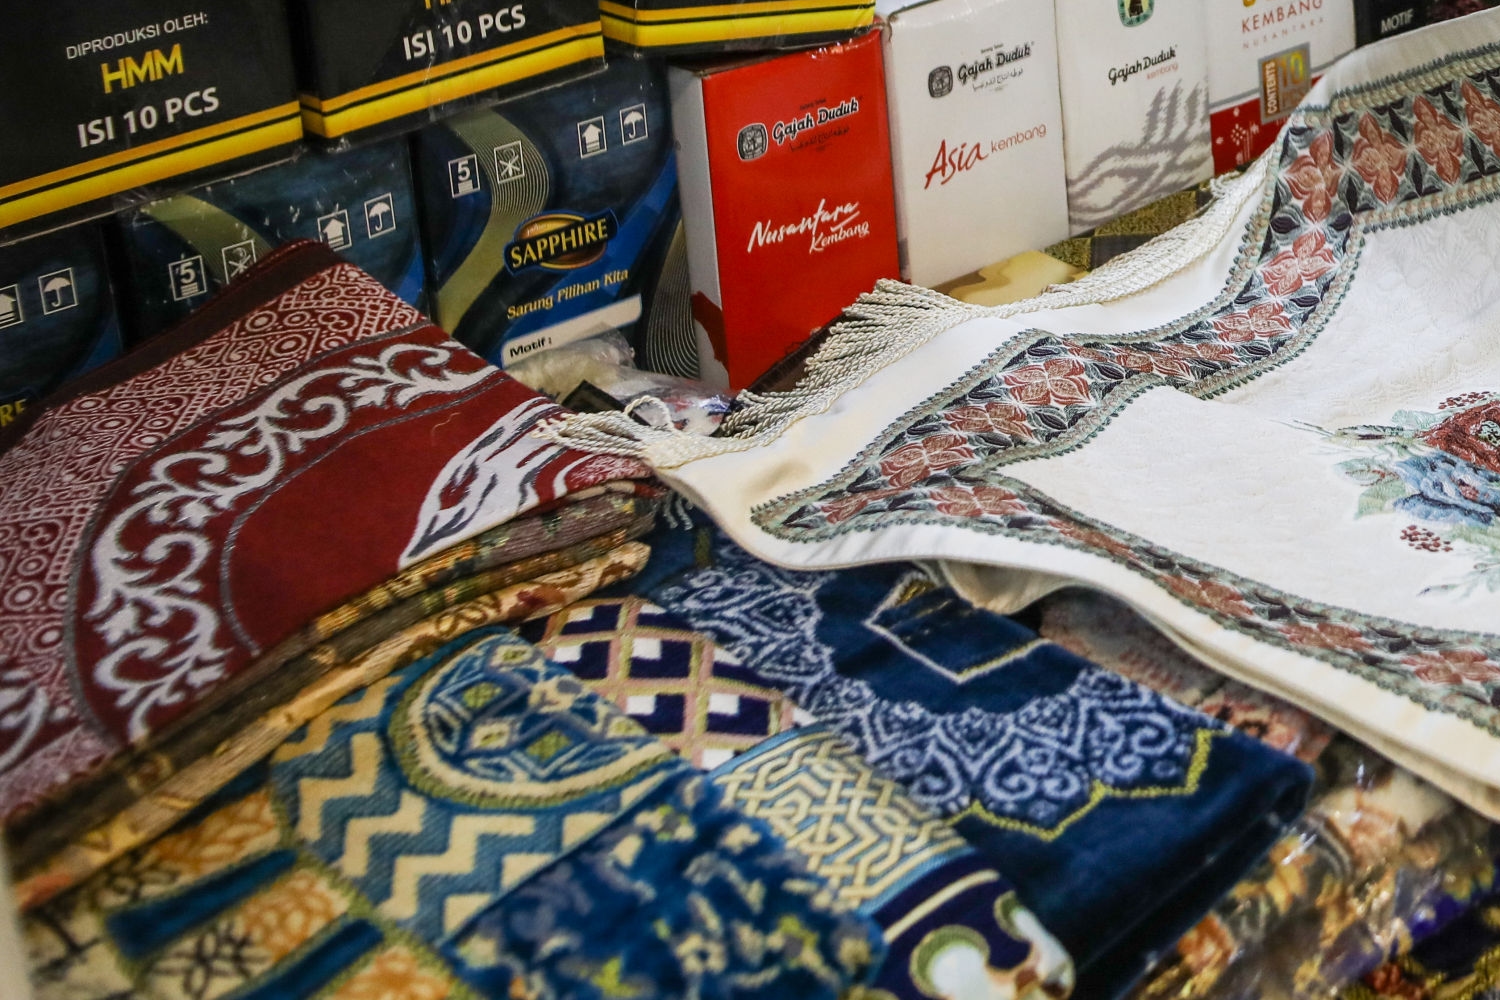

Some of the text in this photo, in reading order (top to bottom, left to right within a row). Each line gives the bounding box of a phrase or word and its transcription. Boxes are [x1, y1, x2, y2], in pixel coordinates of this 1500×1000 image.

[66, 12, 209, 60] DIPRODUKSI OLEH:
[403, 4, 526, 61] ISI 10 PCS
[1243, 17, 1324, 50] NUSANTARA
[1380, 8, 1414, 34] MOTIF
[100, 43, 185, 95] HMM
[958, 58, 993, 86] Gajah
[996, 43, 1031, 68] Duduk
[1108, 46, 1176, 86] Gajah Duduk
[1265, 61, 1278, 114] CONTENTS
[77, 87, 220, 148] ISI 10 PCS
[771, 114, 814, 147] Gajah
[817, 97, 859, 126] Duduk
[457, 160, 471, 182] 5
[924, 124, 1047, 190] Asia kembang
[511, 217, 608, 269] SAPPHIRE
[747, 198, 860, 254] Nusantara
[809, 220, 870, 254] Kembang
[180, 262, 195, 285] 5
[506, 267, 629, 321] Sarung Pilihan Kita
[508, 336, 546, 358] Motif
